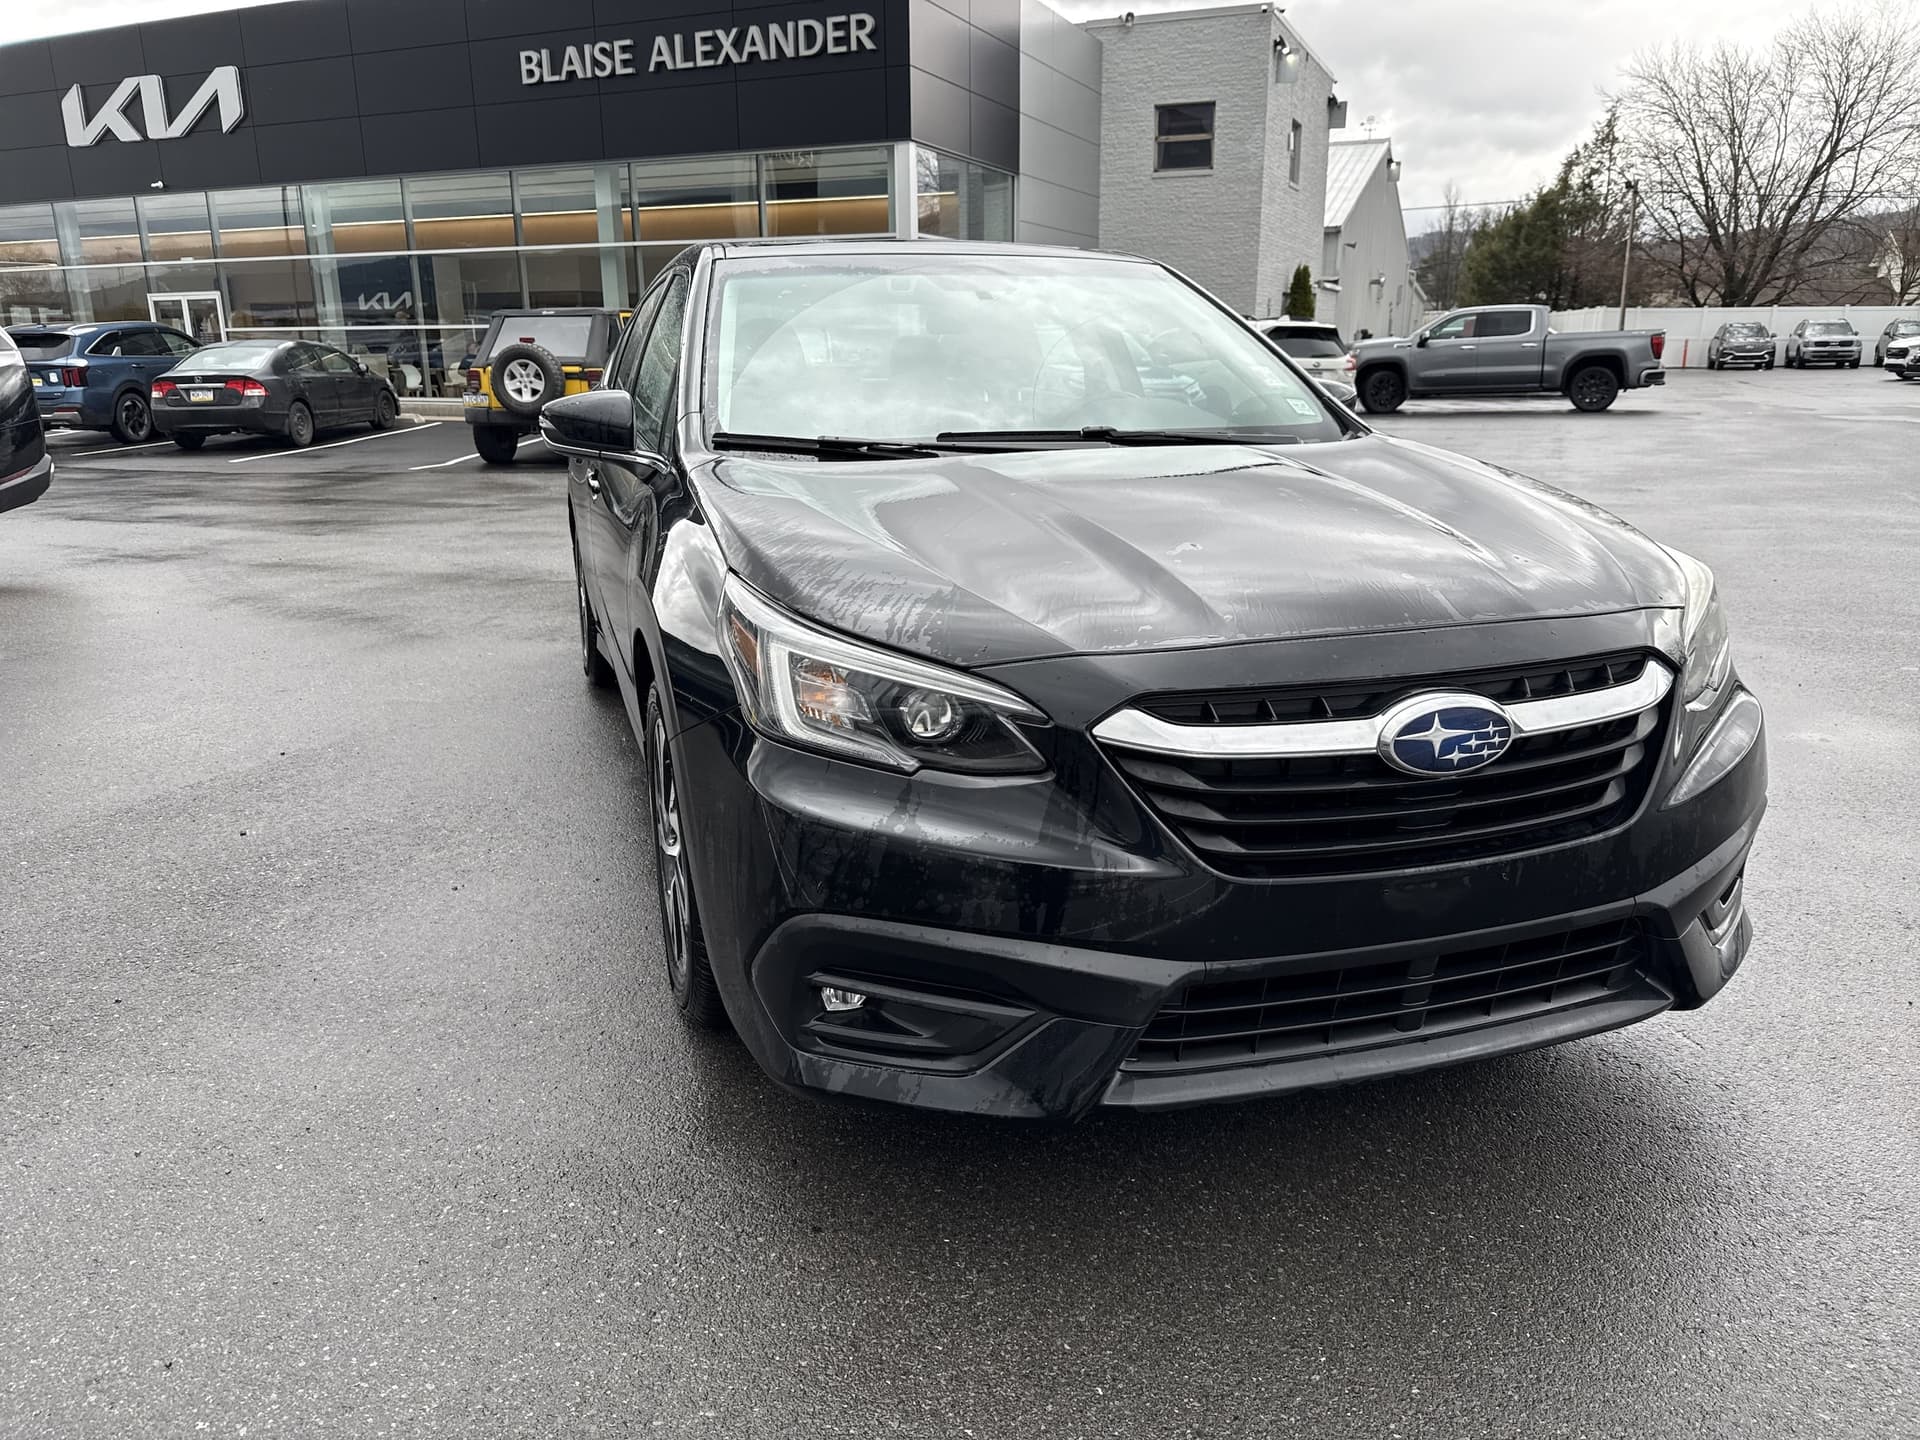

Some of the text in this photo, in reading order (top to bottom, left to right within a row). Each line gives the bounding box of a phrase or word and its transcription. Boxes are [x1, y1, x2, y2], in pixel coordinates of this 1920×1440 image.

[519, 12, 877, 85] BLAISE ALEXANDER
[61, 65, 243, 147] KIA
[358, 291, 412, 310] KIA
